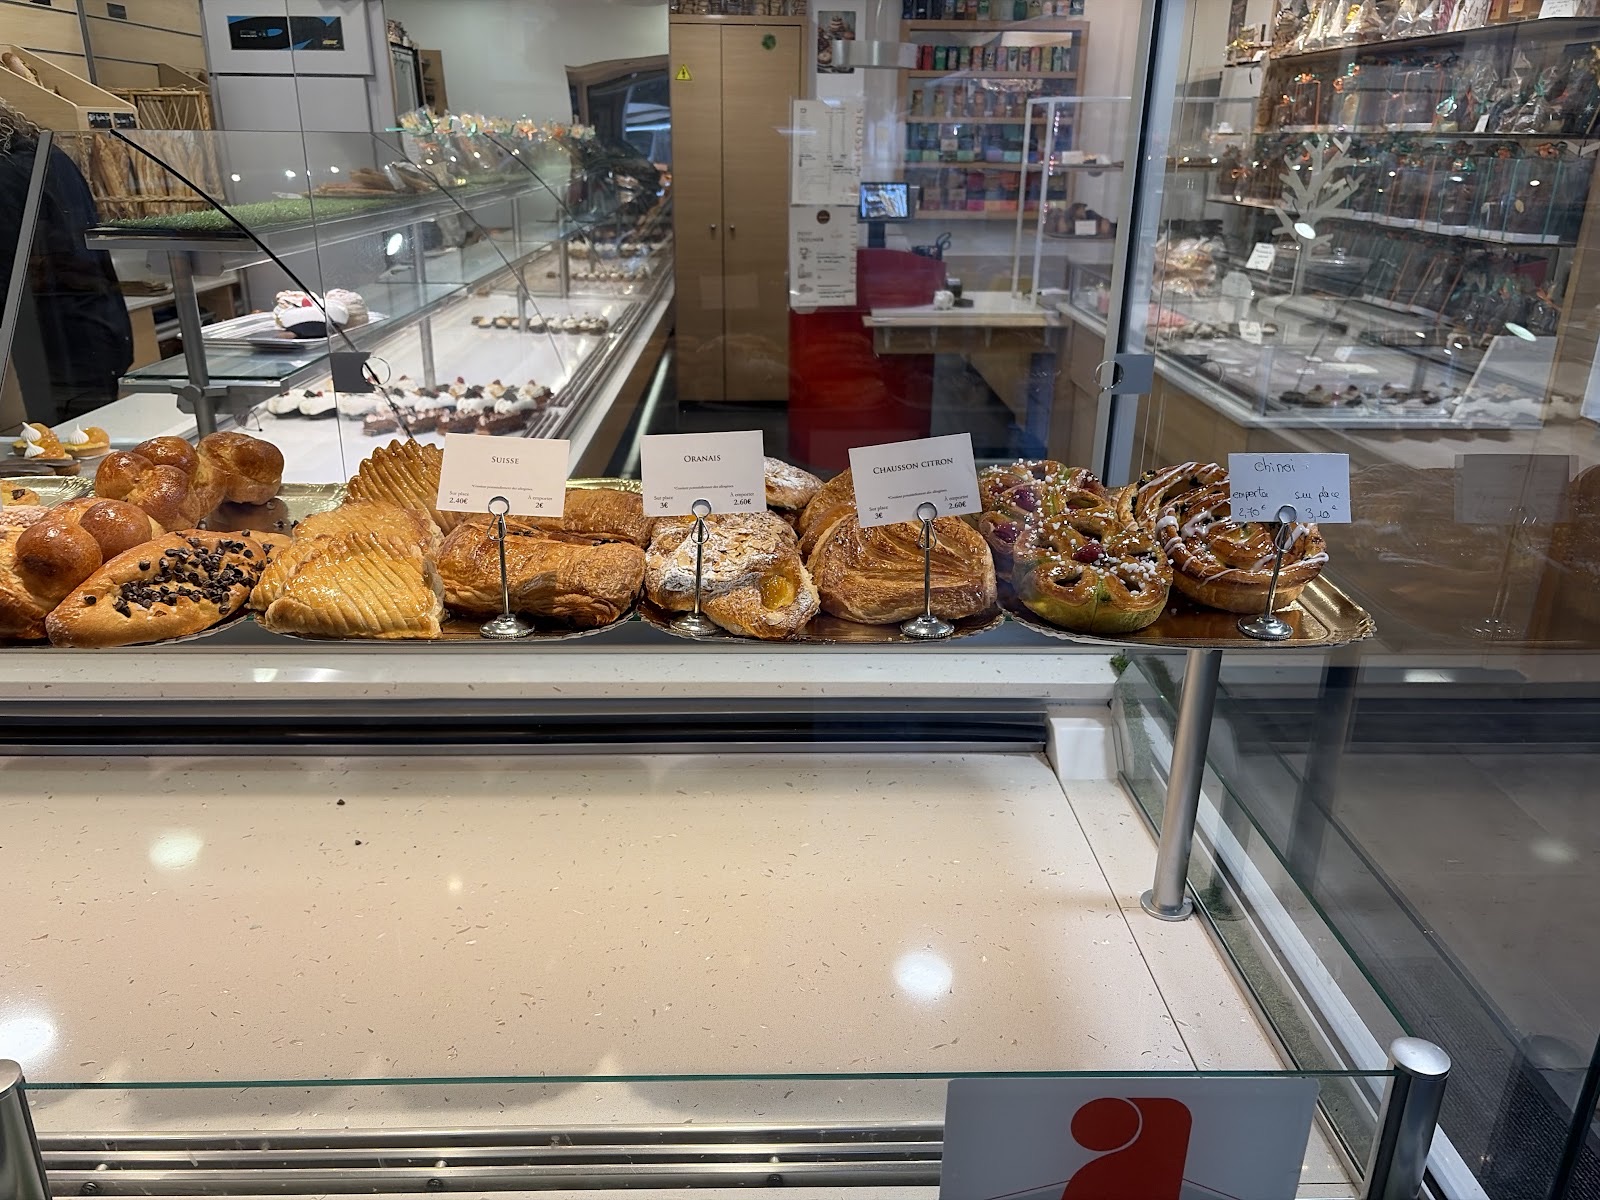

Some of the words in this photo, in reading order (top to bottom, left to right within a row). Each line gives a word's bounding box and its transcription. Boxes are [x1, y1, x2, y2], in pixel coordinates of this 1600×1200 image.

[491, 456, 520, 464] SUISSE
[683, 455, 721, 463] ORANAIS
[872, 462, 919, 475] CHAUSSON
[920, 458, 954, 468] CITRON
[734, 498, 752, 506] 2.60€
[949, 501, 967, 510] 2.60€
[875, 512, 883, 520] 3€
